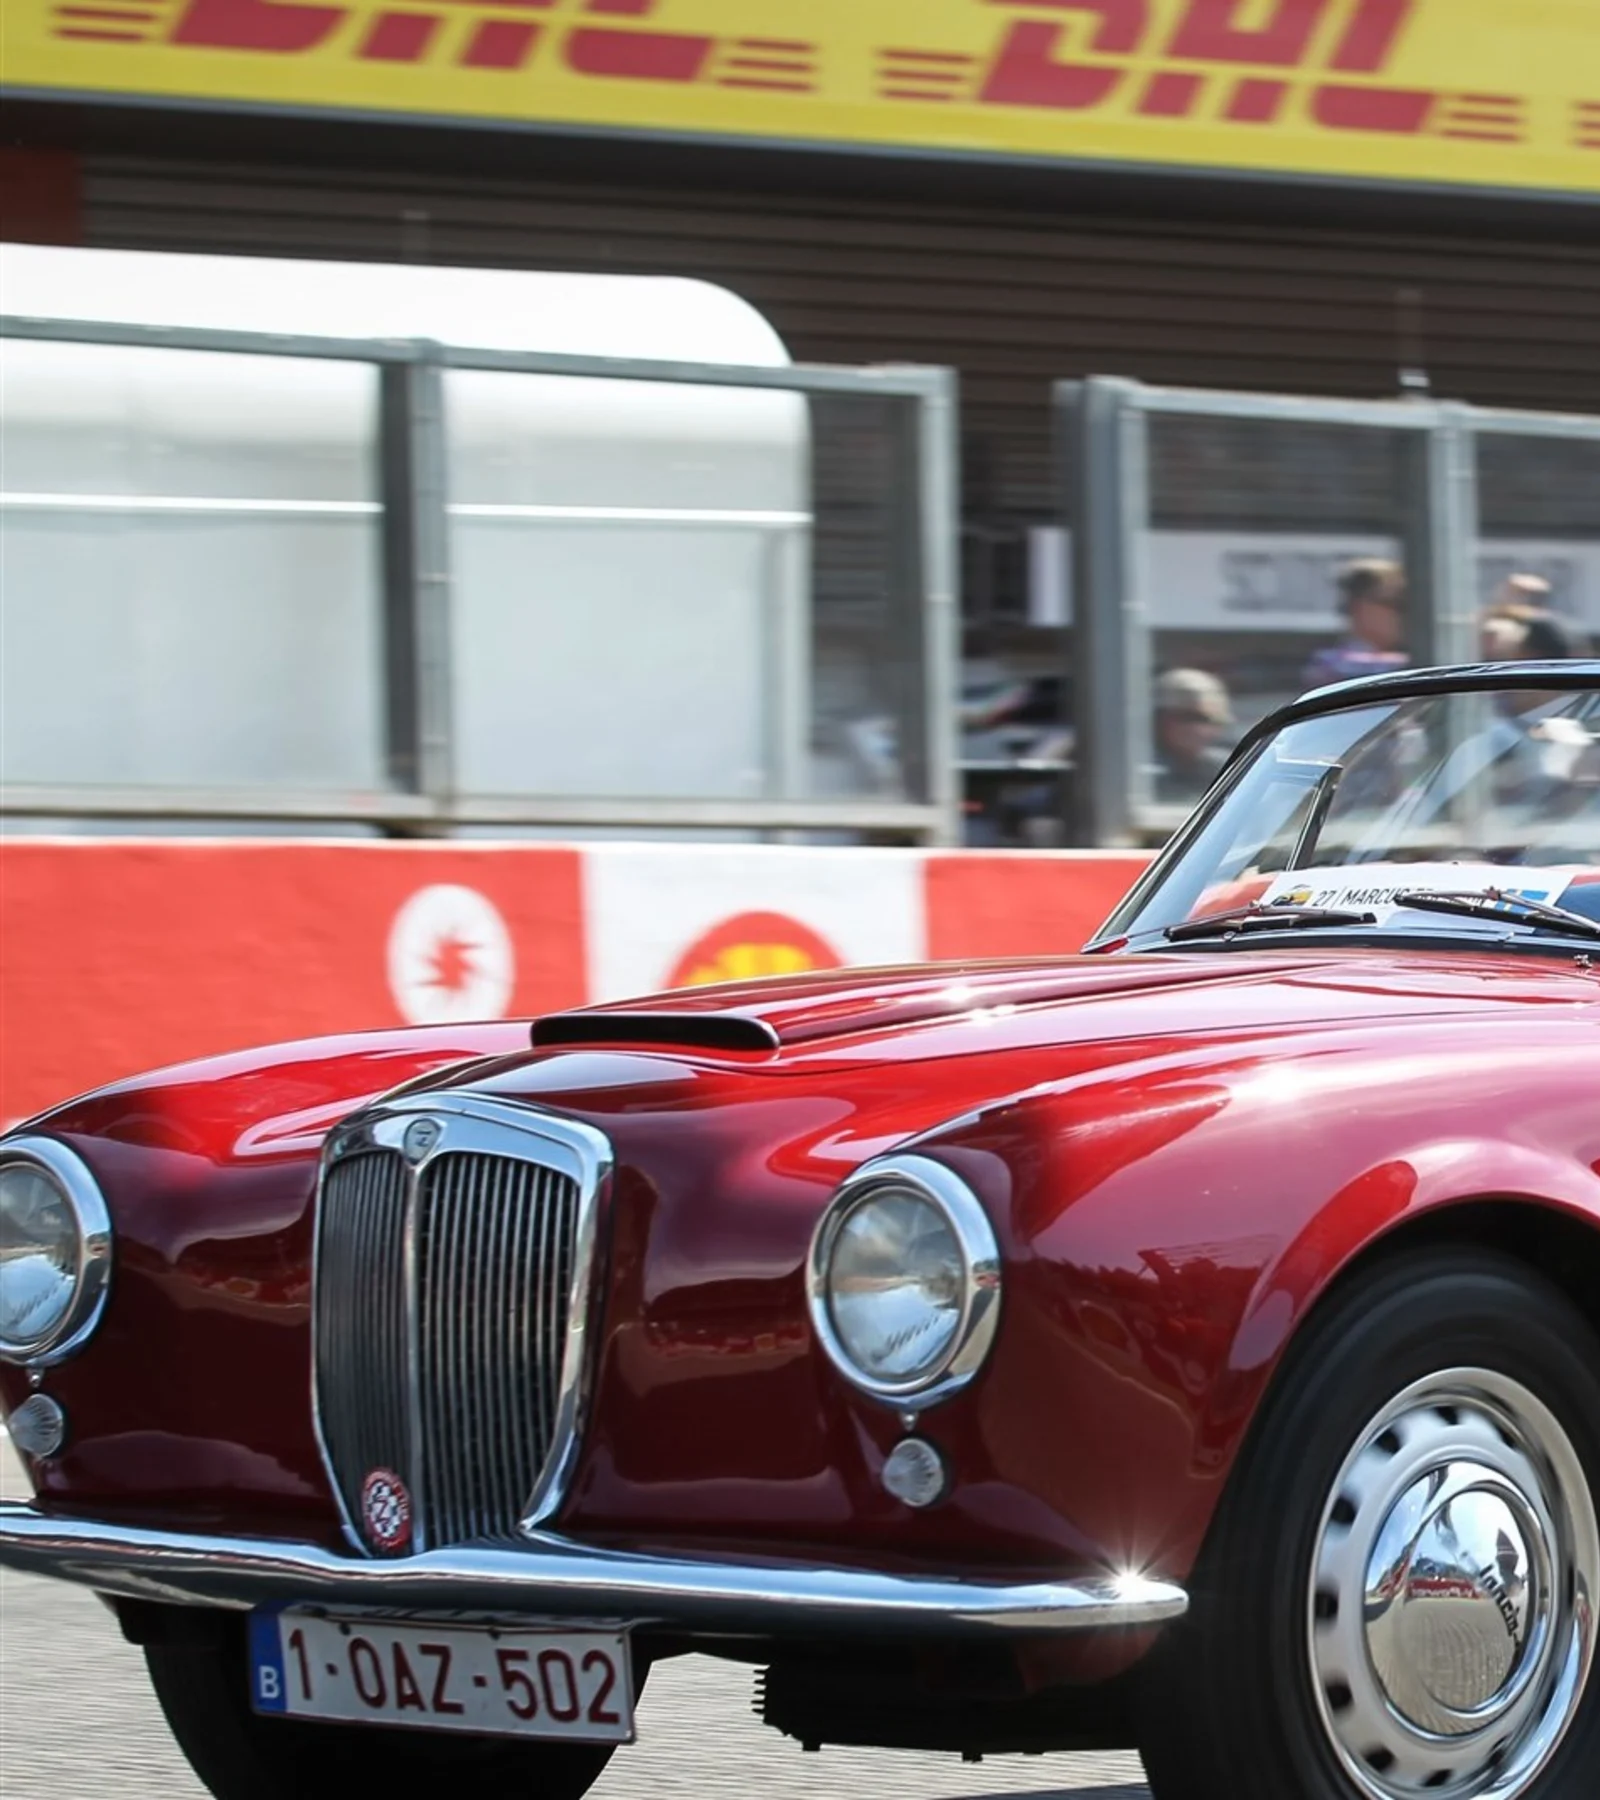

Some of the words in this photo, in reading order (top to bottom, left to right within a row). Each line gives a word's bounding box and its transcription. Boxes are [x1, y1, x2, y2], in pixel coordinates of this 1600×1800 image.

[977, 0, 1440, 135] DHL
[1311, 890, 1336, 907] 27
[259, 1665, 281, 1699] B
[288, 1627, 620, 1725] 1-OAZ-502
